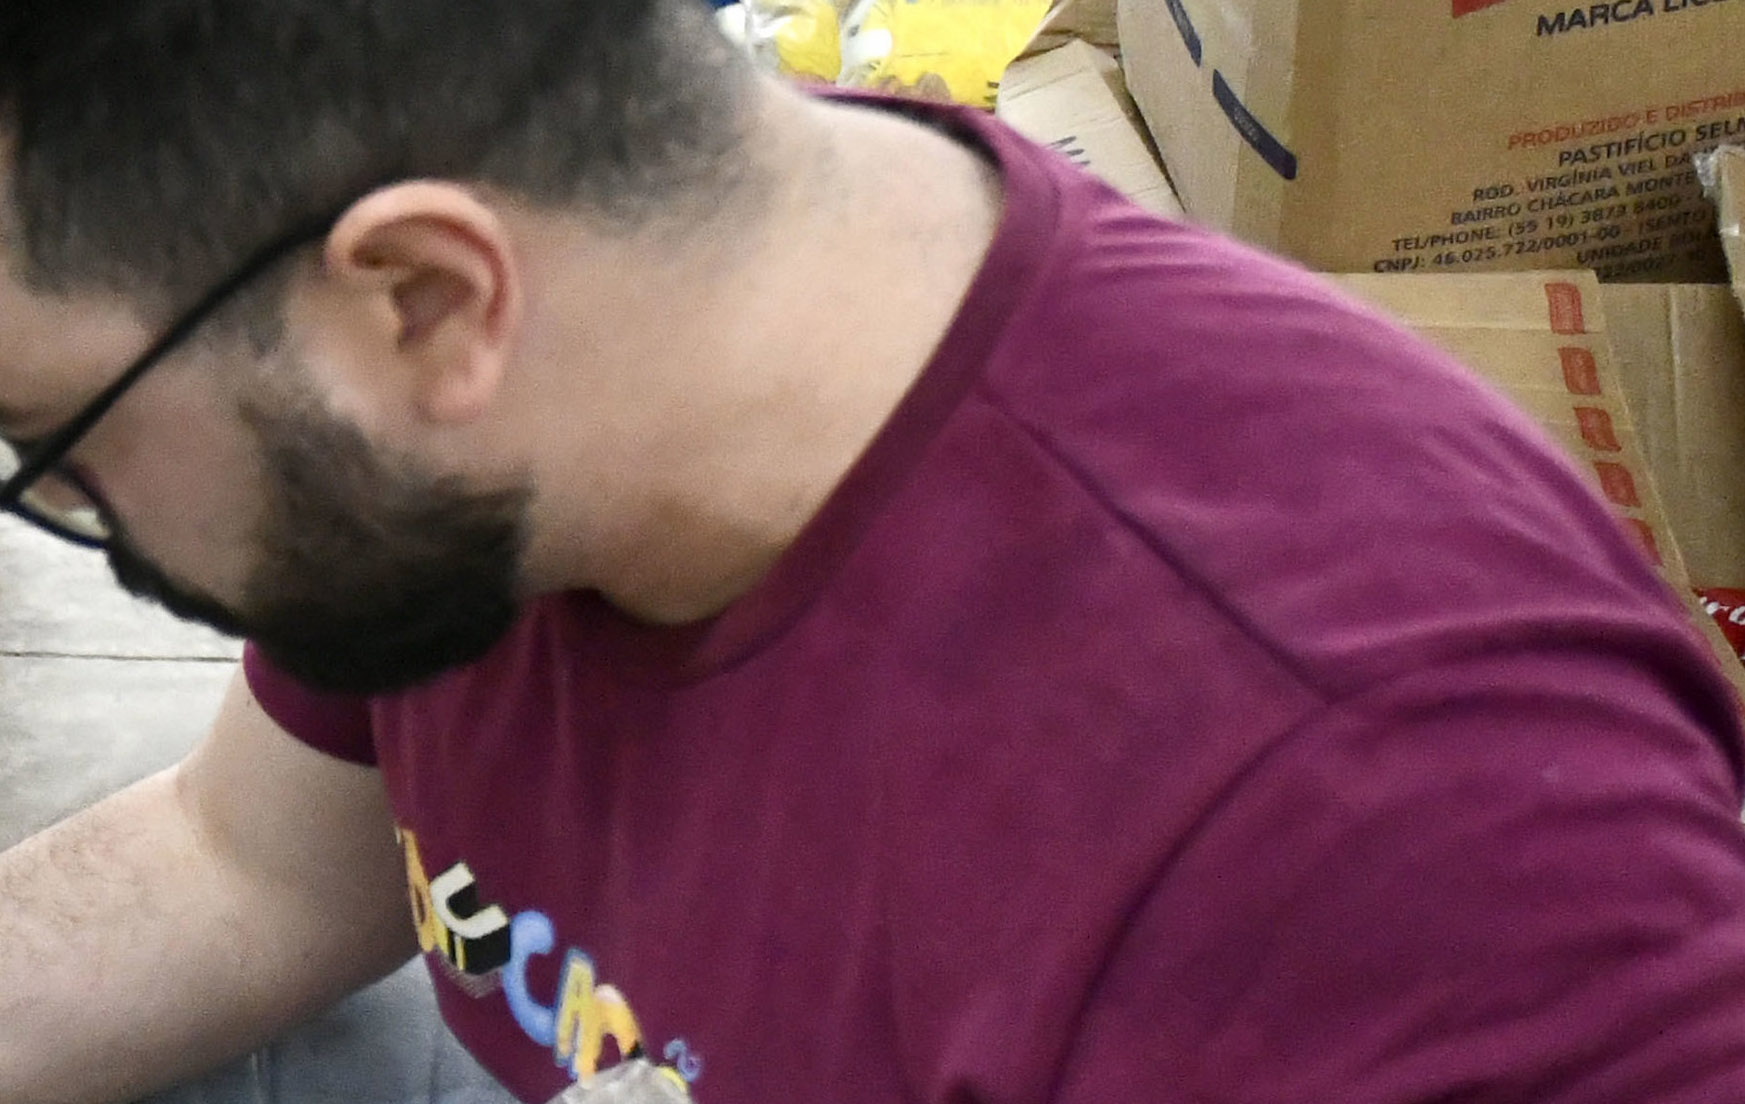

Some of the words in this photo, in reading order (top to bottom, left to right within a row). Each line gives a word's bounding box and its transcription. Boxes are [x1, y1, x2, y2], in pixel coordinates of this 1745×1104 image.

[1536, 0, 1655, 37] MARCA
[1507, 112, 1640, 151] PRODUZIDO
[1646, 109, 1658, 125] E
[1558, 129, 1687, 168] PASTIFÍCIO
[1450, 203, 1522, 226] BAIRRO
[1526, 184, 1620, 213] CHÁCARA
[1626, 172, 1696, 197] MONTE
[1472, 183, 1519, 202] ROD.
[1527, 164, 1613, 193] VIRGÍNIA
[1617, 157, 1657, 177] VIEL
[1546, 213, 1575, 232] 19)
[1580, 205, 1627, 225] 3873
[1373, 256, 1426, 274] CNPJ:
